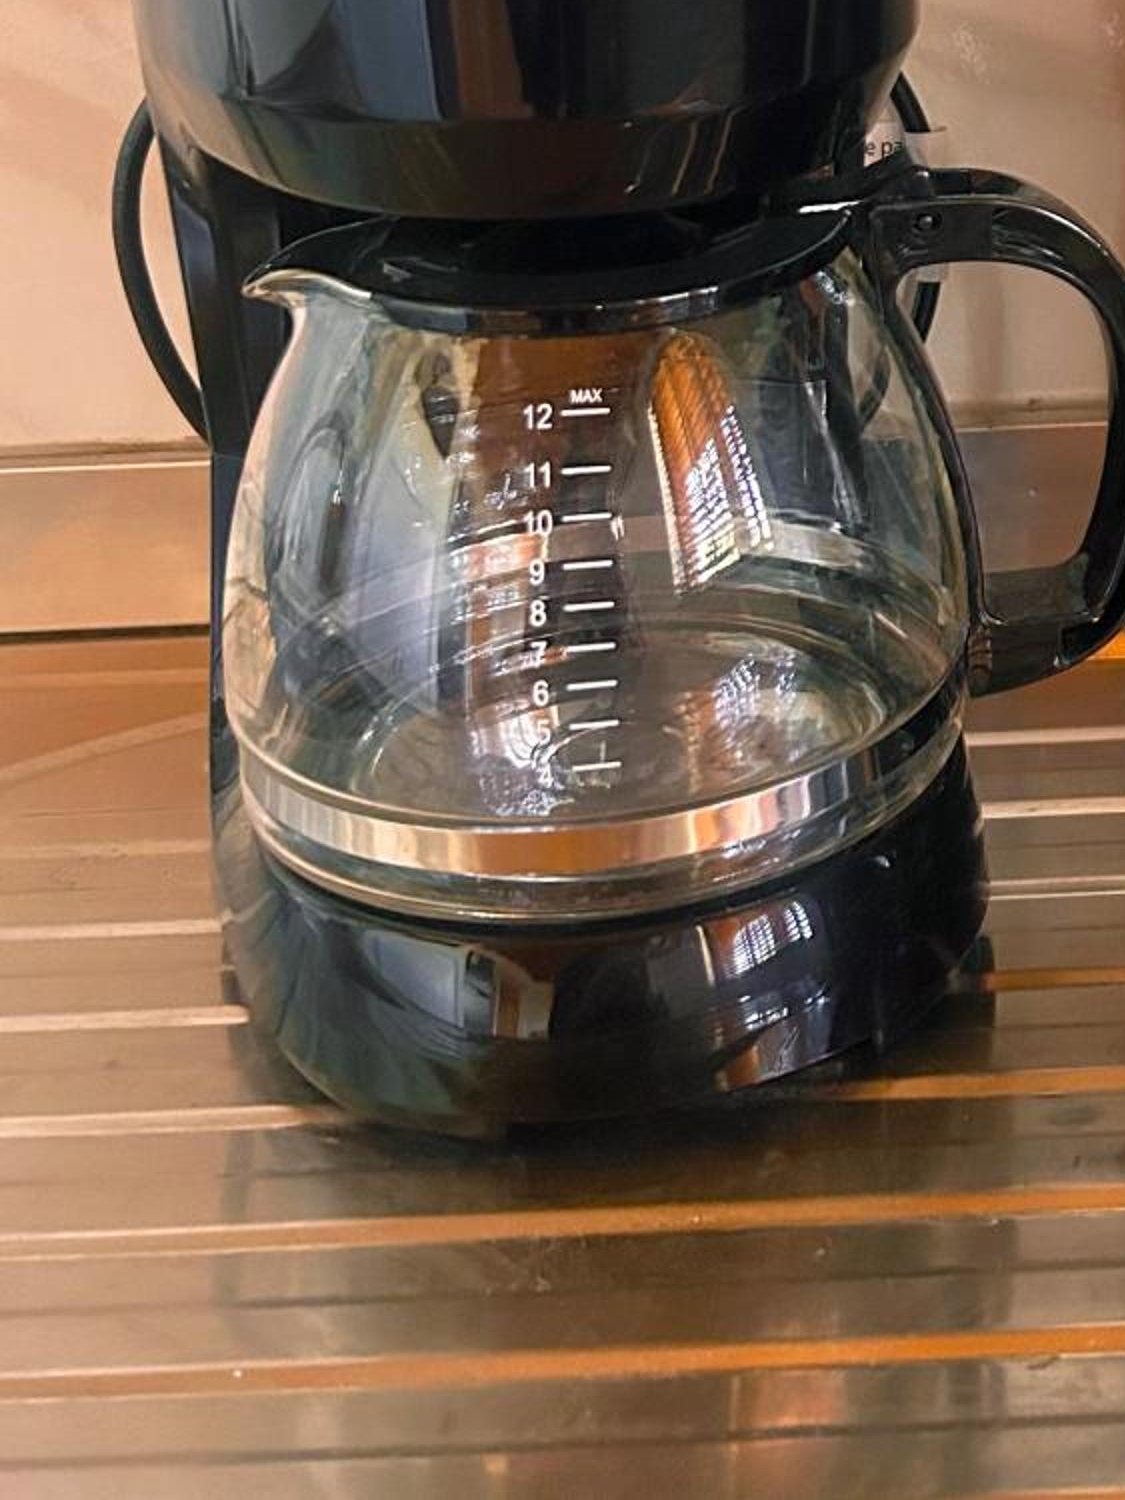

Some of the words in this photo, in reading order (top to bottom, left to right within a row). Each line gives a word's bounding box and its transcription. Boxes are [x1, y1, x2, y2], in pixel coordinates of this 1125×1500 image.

[570, 388, 603, 403] MAX
[523, 403, 553, 430] 12
[525, 461, 552, 488] 11
[523, 509, 553, 536] 10
[528, 559, 545, 586] 9
[529, 599, 547, 627] 8
[531, 640, 548, 668] 7
[532, 679, 550, 707] 6
